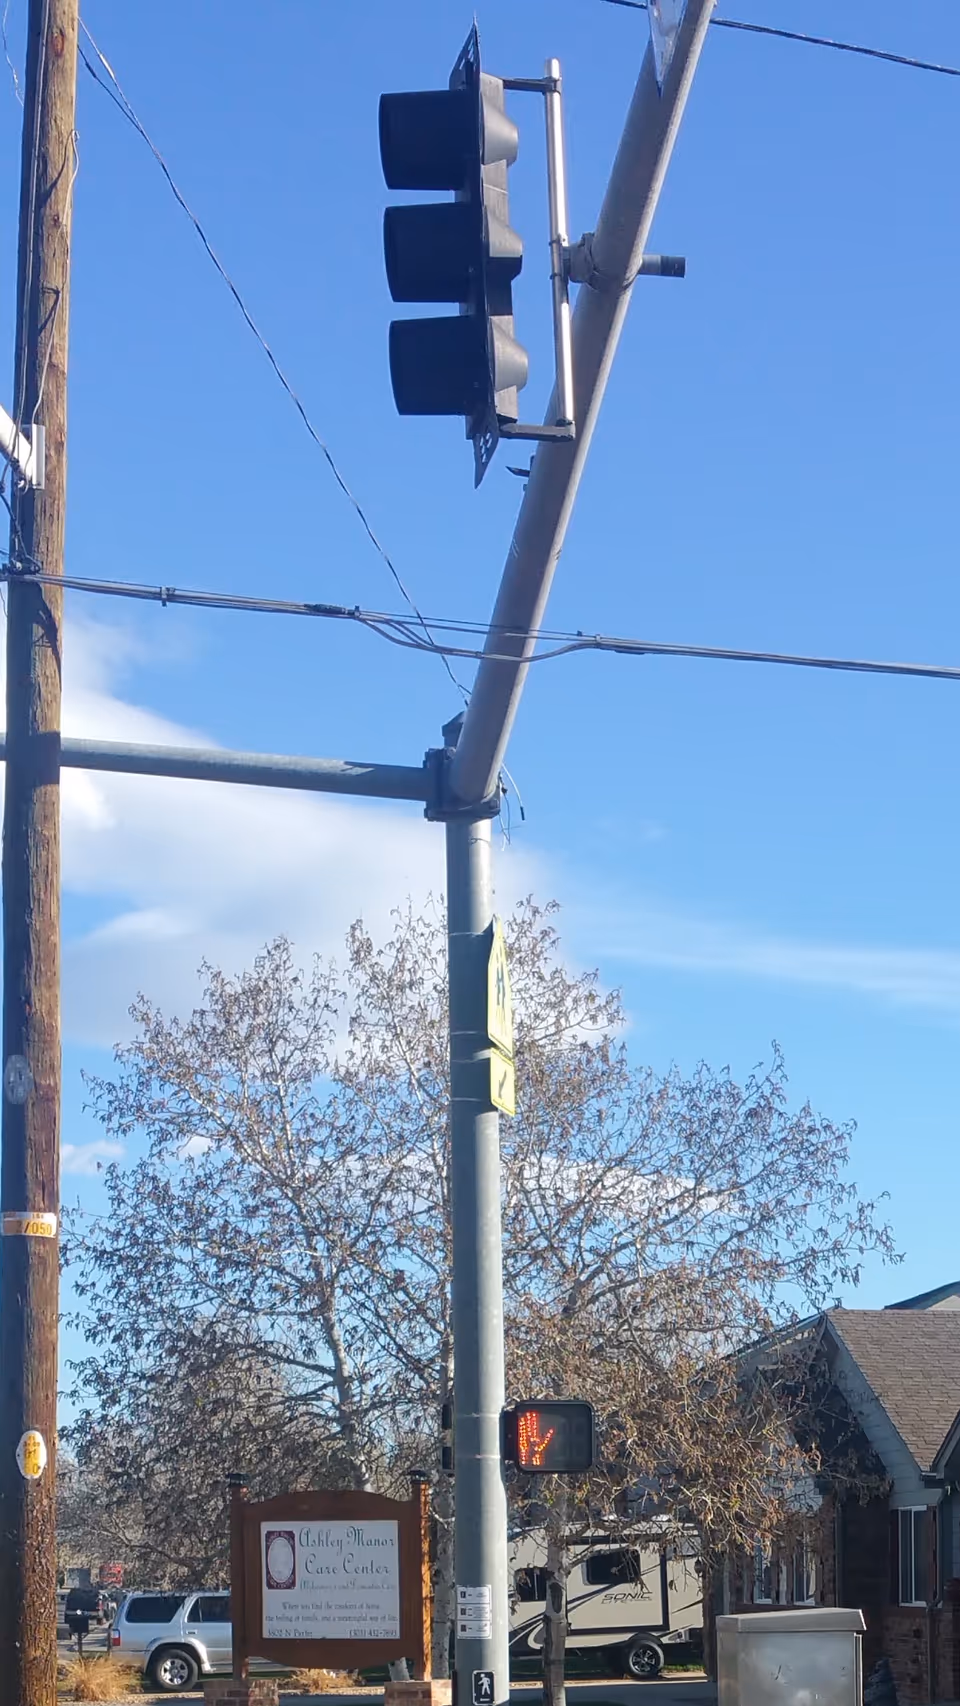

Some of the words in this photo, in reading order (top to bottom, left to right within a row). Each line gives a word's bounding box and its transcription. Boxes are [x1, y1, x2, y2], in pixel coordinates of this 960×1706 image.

[299, 1526, 343, 1555] Ashley
[346, 1526, 395, 1547] Manor
[305, 1553, 338, 1575] Care
[343, 1553, 390, 1575] Center
[604, 1592, 652, 1600] SONIC
